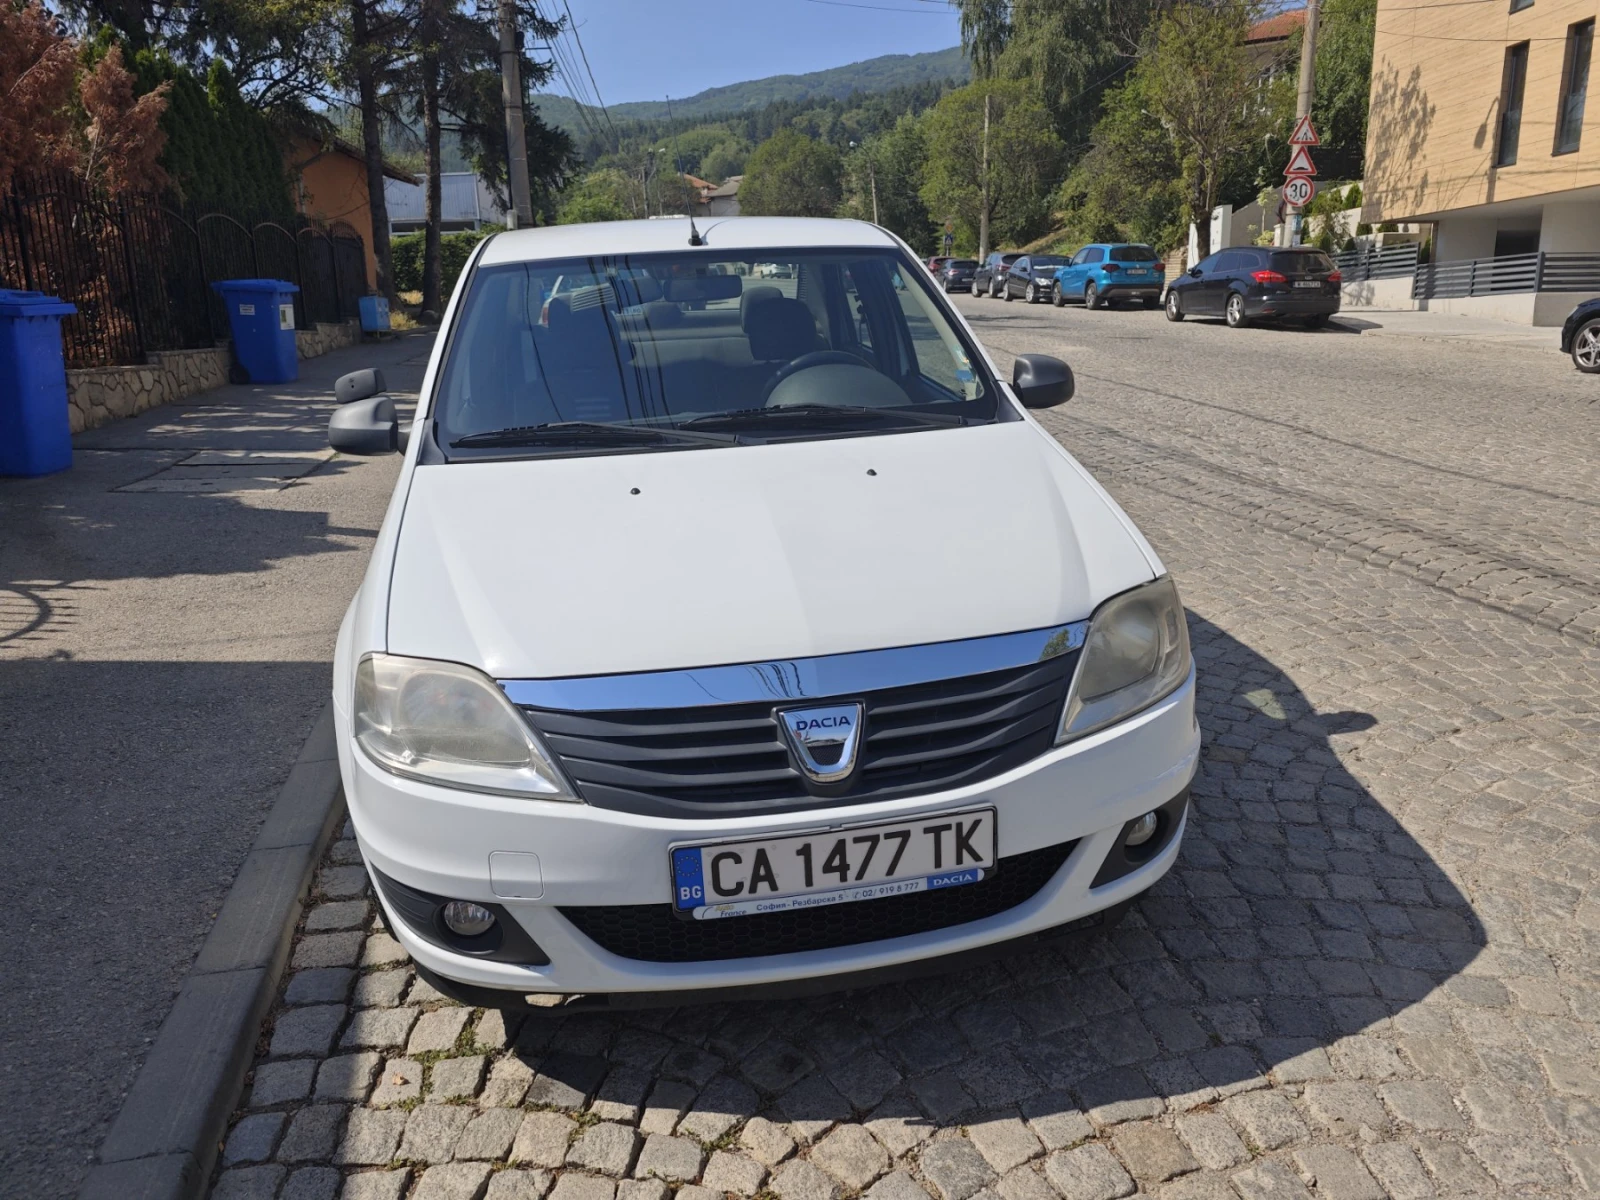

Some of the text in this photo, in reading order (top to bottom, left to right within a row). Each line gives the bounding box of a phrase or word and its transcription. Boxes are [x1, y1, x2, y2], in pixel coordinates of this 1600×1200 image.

[1290, 183, 1308, 198] 30
[796, 715, 851, 731] DACIA
[710, 818, 984, 897] CA 1477 TK
[933, 873, 973, 886] DACIA
[680, 885, 703, 901] BG
[792, 896, 836, 908] Резбарска
[880, 886, 895, 895] 919
[904, 882, 919, 891] 777
[720, 909, 747, 918] France
